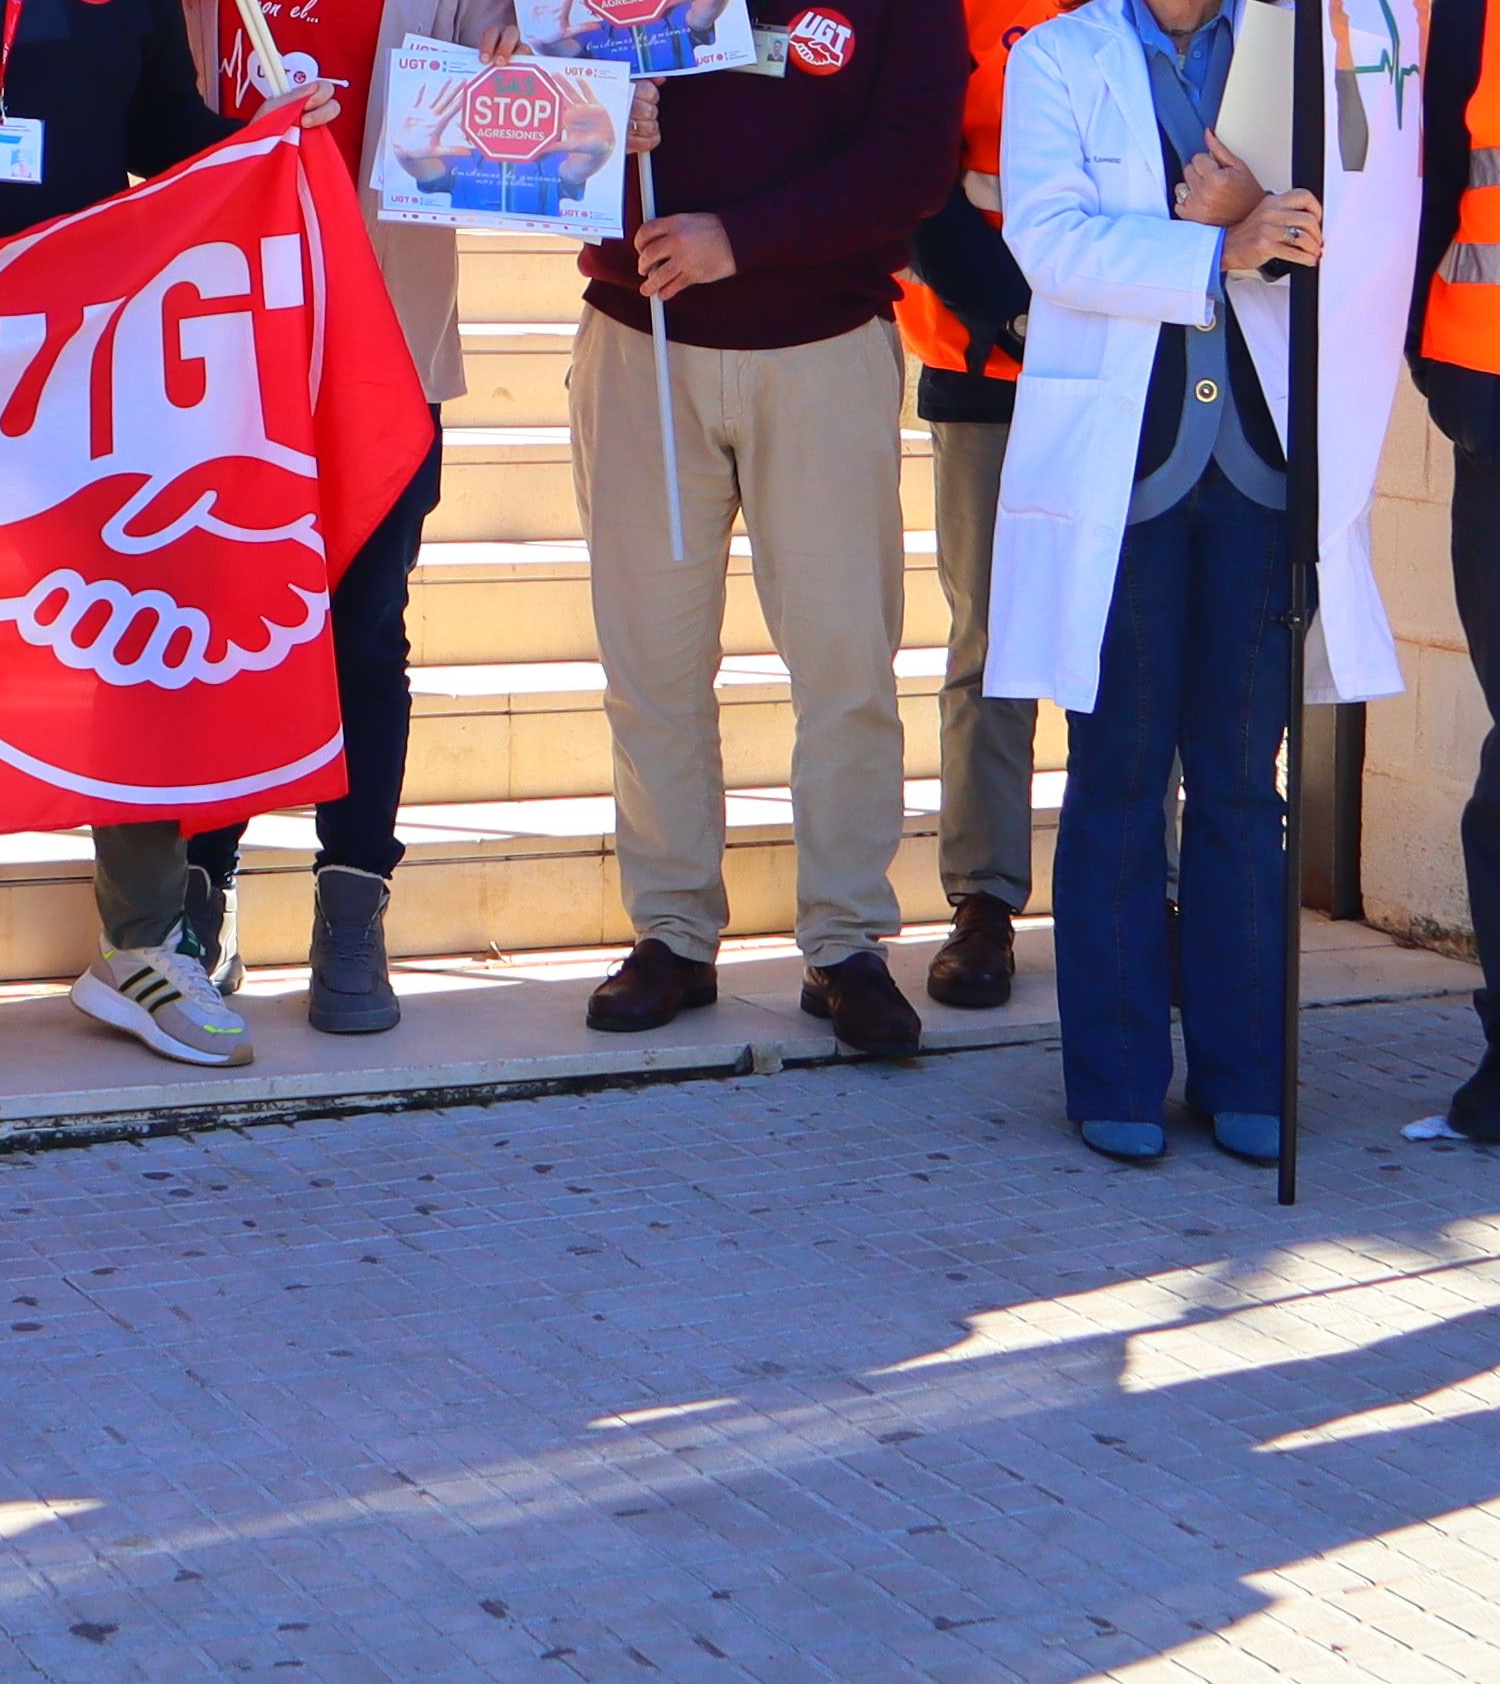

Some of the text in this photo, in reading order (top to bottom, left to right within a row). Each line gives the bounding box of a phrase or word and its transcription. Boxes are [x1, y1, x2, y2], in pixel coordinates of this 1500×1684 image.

[796, 11, 852, 53] UGT
[399, 58, 427, 71] UGT
[696, 54, 716, 65] UGT
[565, 66, 584, 77] UGT
[492, 74, 537, 96] SAS
[473, 96, 552, 128] STOP
[477, 127, 546, 142] AGRESIONES
[391, 194, 410, 204] UGT
[560, 208, 579, 218] UGT
